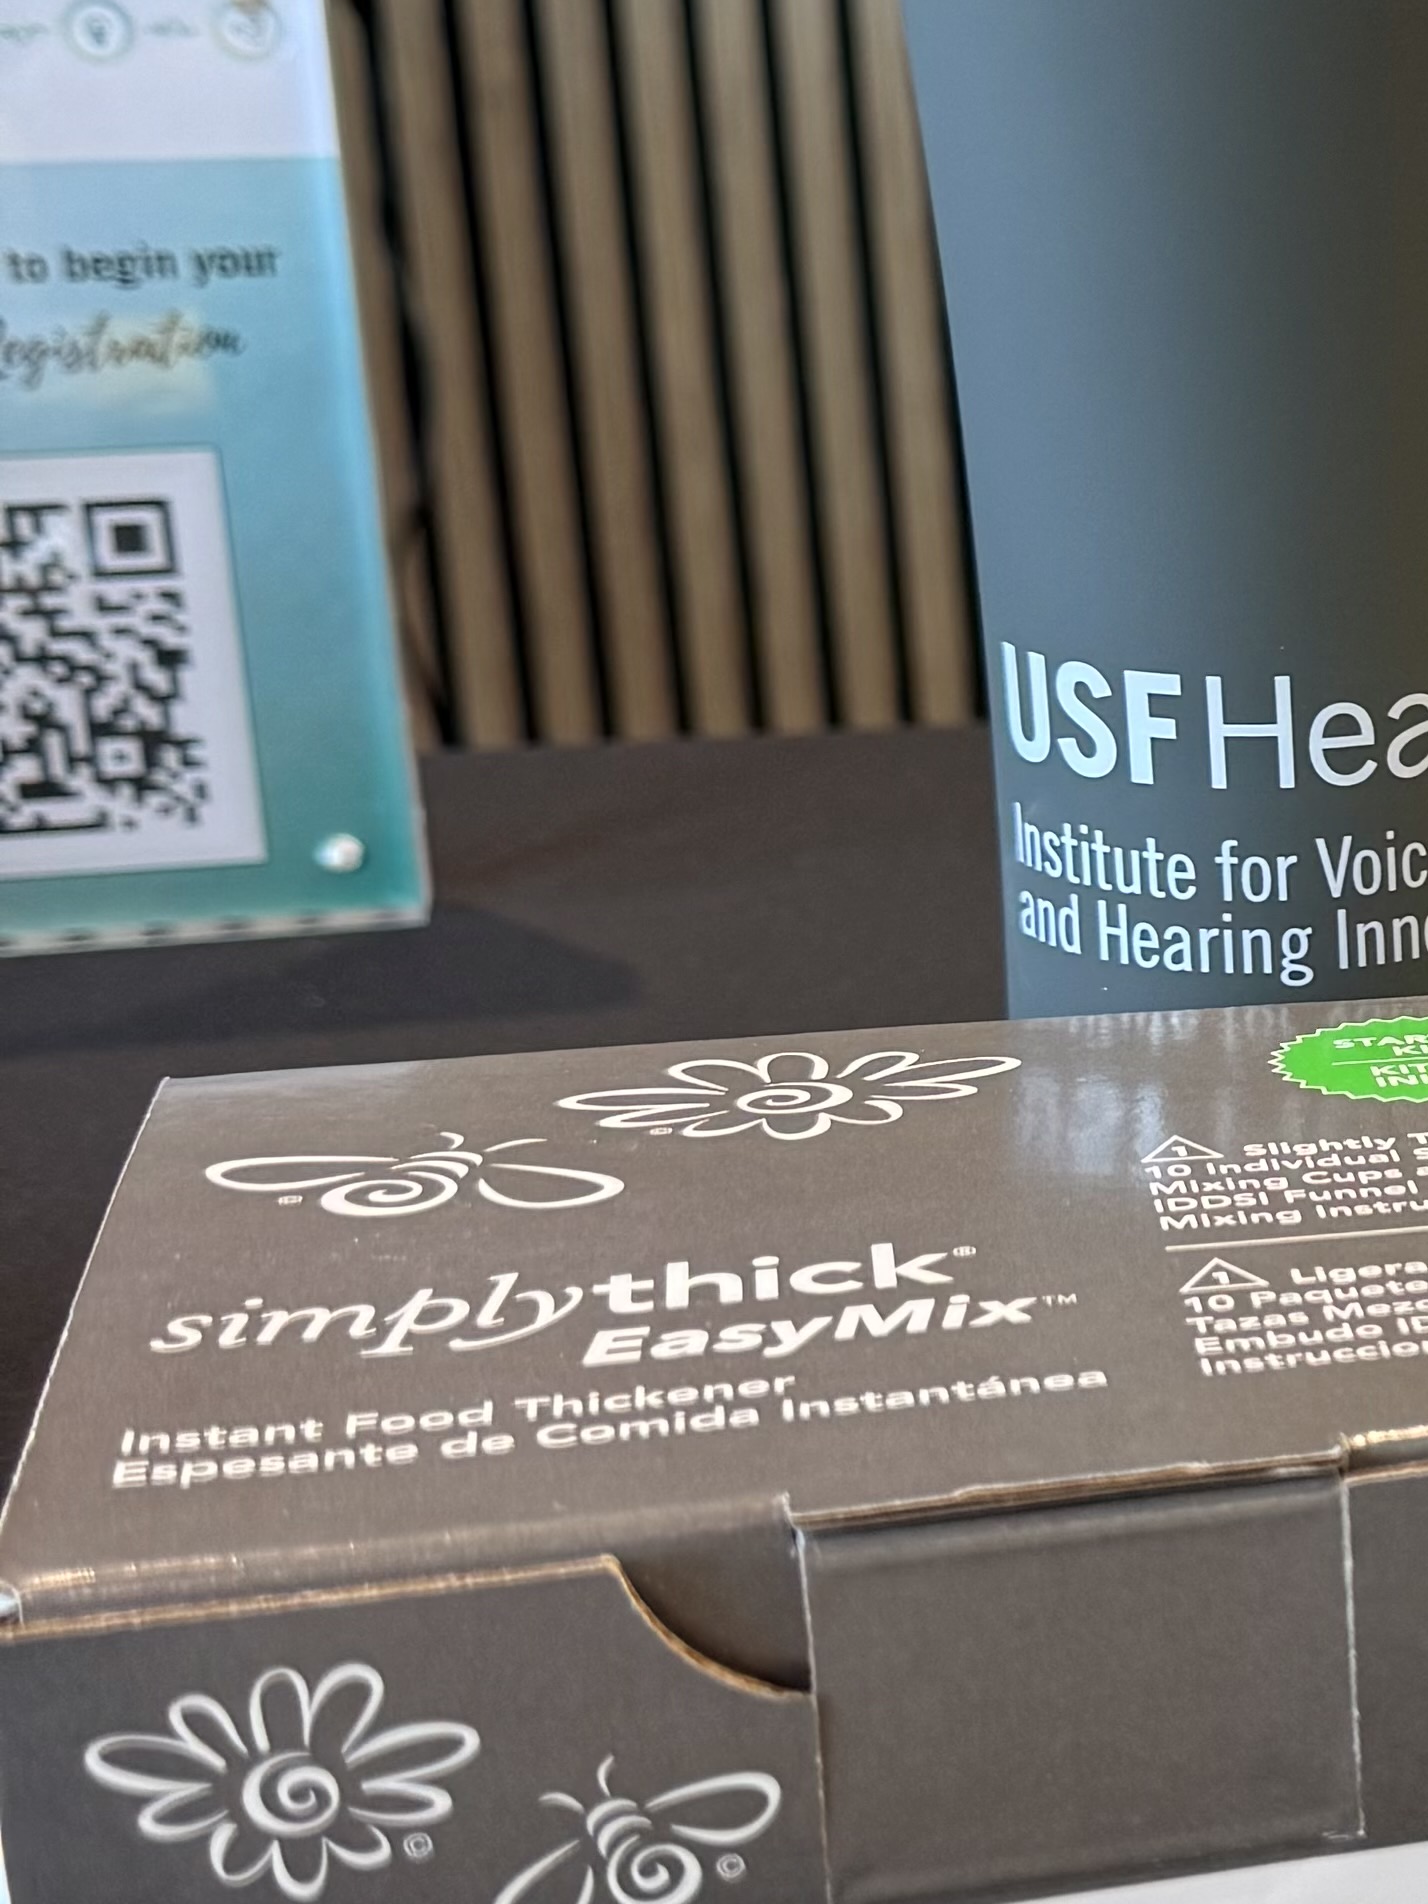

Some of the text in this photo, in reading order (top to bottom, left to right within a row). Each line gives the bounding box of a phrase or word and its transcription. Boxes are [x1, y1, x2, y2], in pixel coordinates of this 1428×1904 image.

[3, 241, 279, 290] to begin your
[1012, 801, 1197, 900] Institute
[1214, 839, 1298, 903] for
[1018, 888, 1082, 955] and
[1099, 899, 1314, 987] Hearing
[1243, 1135, 1396, 1157] Slightly
[1144, 1164, 1192, 1180] 10
[1206, 1148, 1401, 1176] Individual
[1149, 1174, 1289, 1196] Mixing
[1301, 1167, 1404, 1187] Cups
[1153, 1192, 1270, 1214] IDDSI
[1284, 1179, 1419, 1204] Funnel
[1159, 1208, 1303, 1231] Mixing
[1184, 1293, 1236, 1314] 10
[1185, 1310, 1311, 1335] Tazas
[1194, 1322, 1384, 1356] Embudo
[112, 1367, 1108, 1490] Espesante de Comida Instantánea
[120, 1374, 796, 1457] Instant Food Thickener
